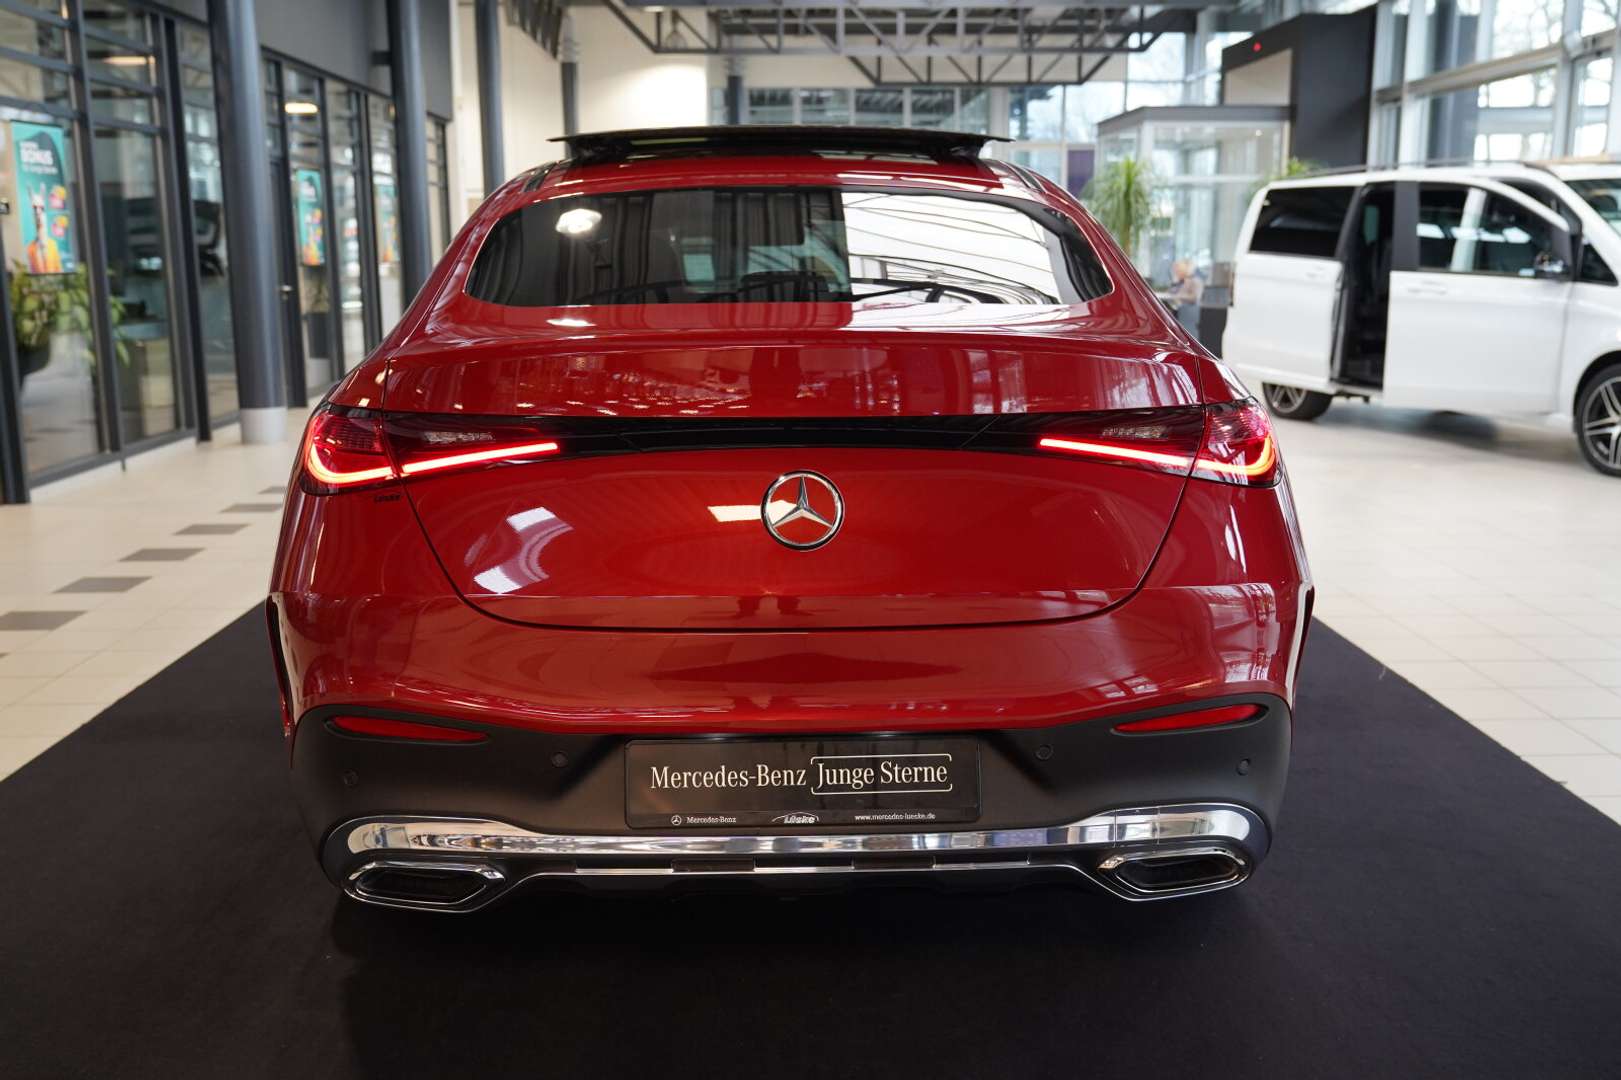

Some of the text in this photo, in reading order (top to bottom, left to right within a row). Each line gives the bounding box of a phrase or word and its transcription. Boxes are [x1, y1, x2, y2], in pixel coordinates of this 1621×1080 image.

[651, 760, 948, 790] Mercedes-Benz Junge Sterne
[686, 815, 737, 824] Mercedes-Benz
